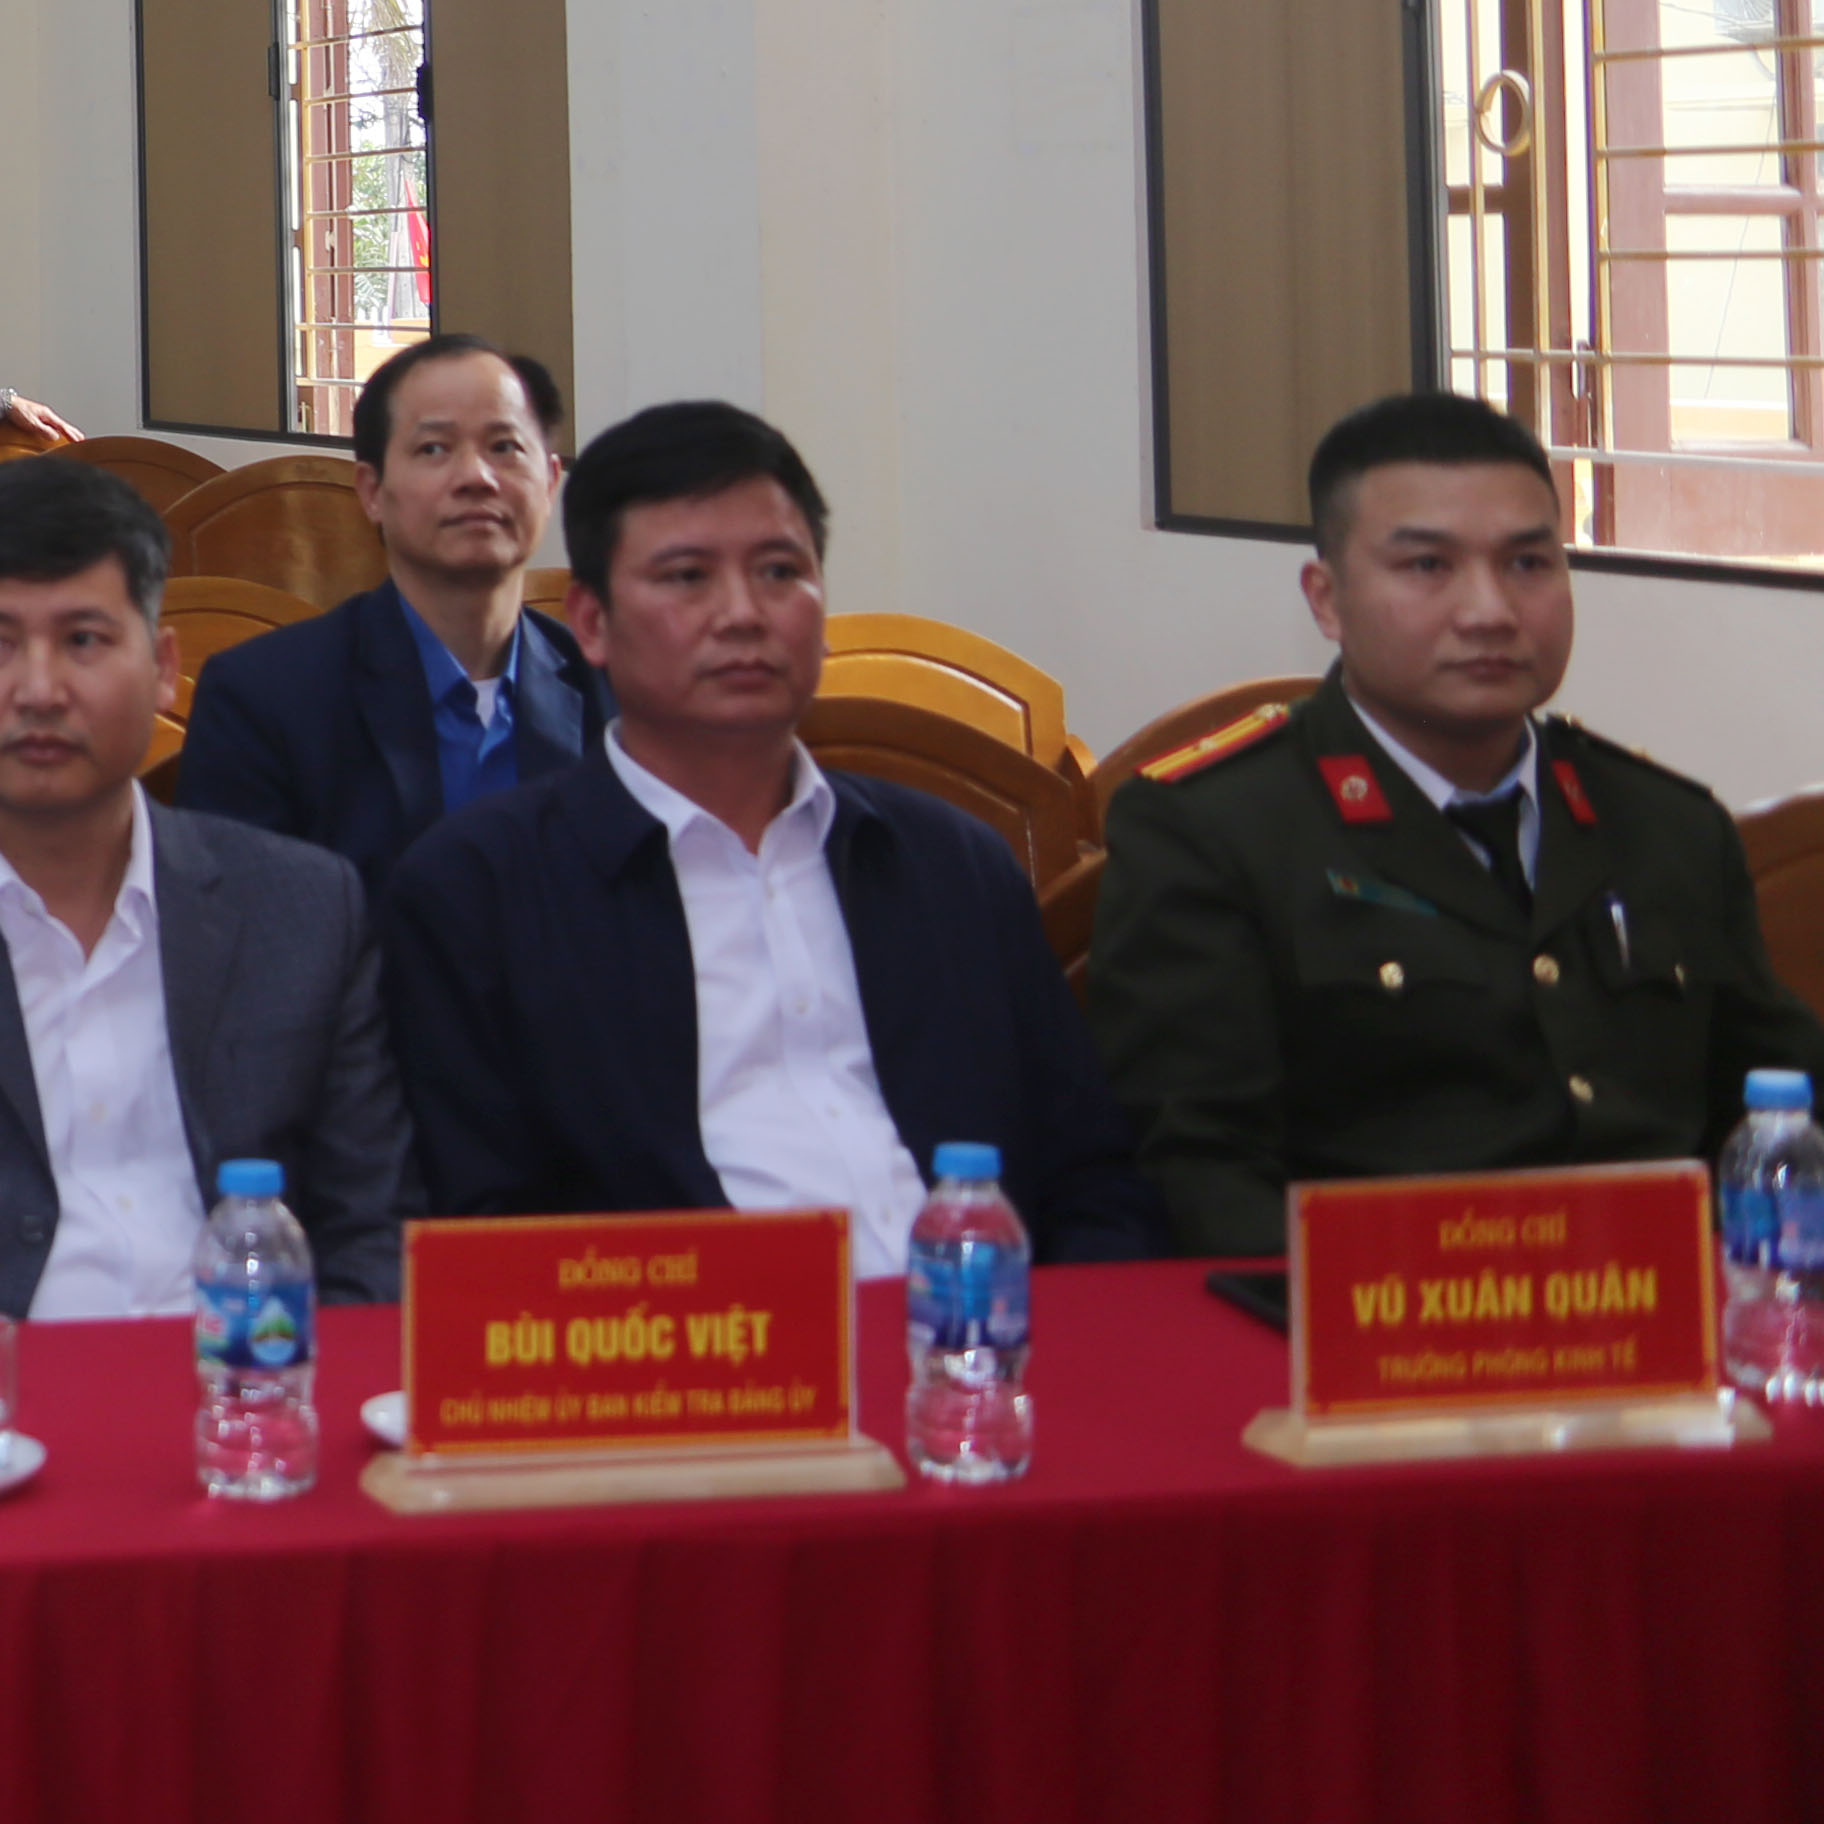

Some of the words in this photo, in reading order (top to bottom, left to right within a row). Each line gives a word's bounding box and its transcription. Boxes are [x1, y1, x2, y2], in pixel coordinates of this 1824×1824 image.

[1419, 1267, 1533, 1323] XUÂN
[1545, 1259, 1657, 1321] QUÂN
[485, 1310, 555, 1366] BÙI
[566, 1302, 676, 1366] QUỐC
[686, 1304, 772, 1365] VIỆT
